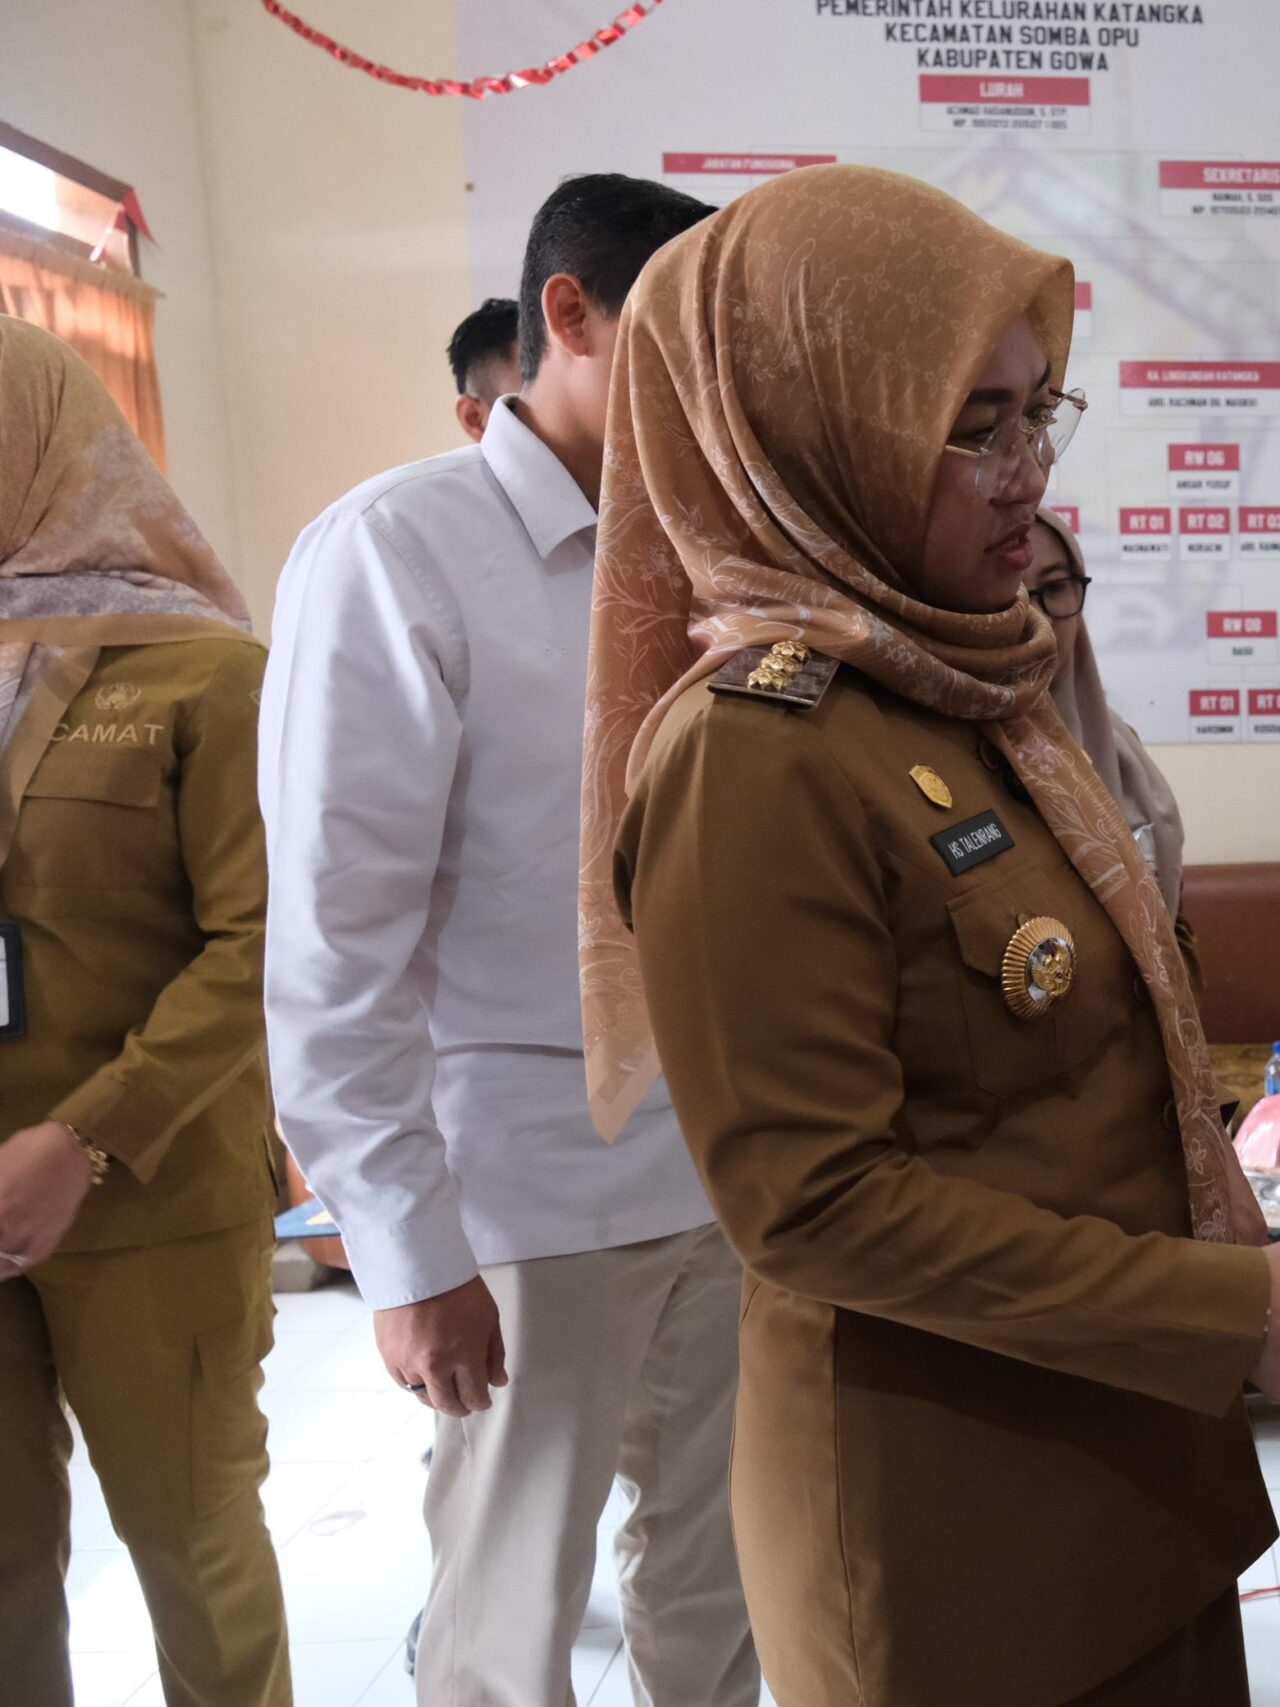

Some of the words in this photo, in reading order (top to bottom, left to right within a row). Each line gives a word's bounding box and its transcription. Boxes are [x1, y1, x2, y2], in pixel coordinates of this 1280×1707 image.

[816, 0, 953, 18] PEMERINTAH
[960, 0, 1086, 21] KELURAHAN
[1093, 2, 1203, 24] KATANGKA
[885, 23, 1012, 44] KECAMATAN
[1019, 26, 1091, 46] SOMBA
[1098, 28, 1139, 47] OPU
[917, 48, 1042, 70] KABUPATEN
[1050, 52, 1109, 71] GOWA
[979, 82, 1024, 97] LURAH
[1184, 450, 1204, 467] RW
[1129, 514, 1147, 531] RT
[1149, 514, 1165, 530] 01
[1187, 513, 1204, 529] RT
[1206, 513, 1225, 529] 02
[1247, 513, 1265, 529] RT
[1222, 617, 1242, 633] RW
[1200, 695, 1218, 711] RT
[1219, 695, 1235, 710] 01
[1256, 694, 1274, 710] RT
[50, 723, 164, 745] CAMAT
[947, 842, 963, 859] HS
[958, 823, 1001, 852] TALENRANG
